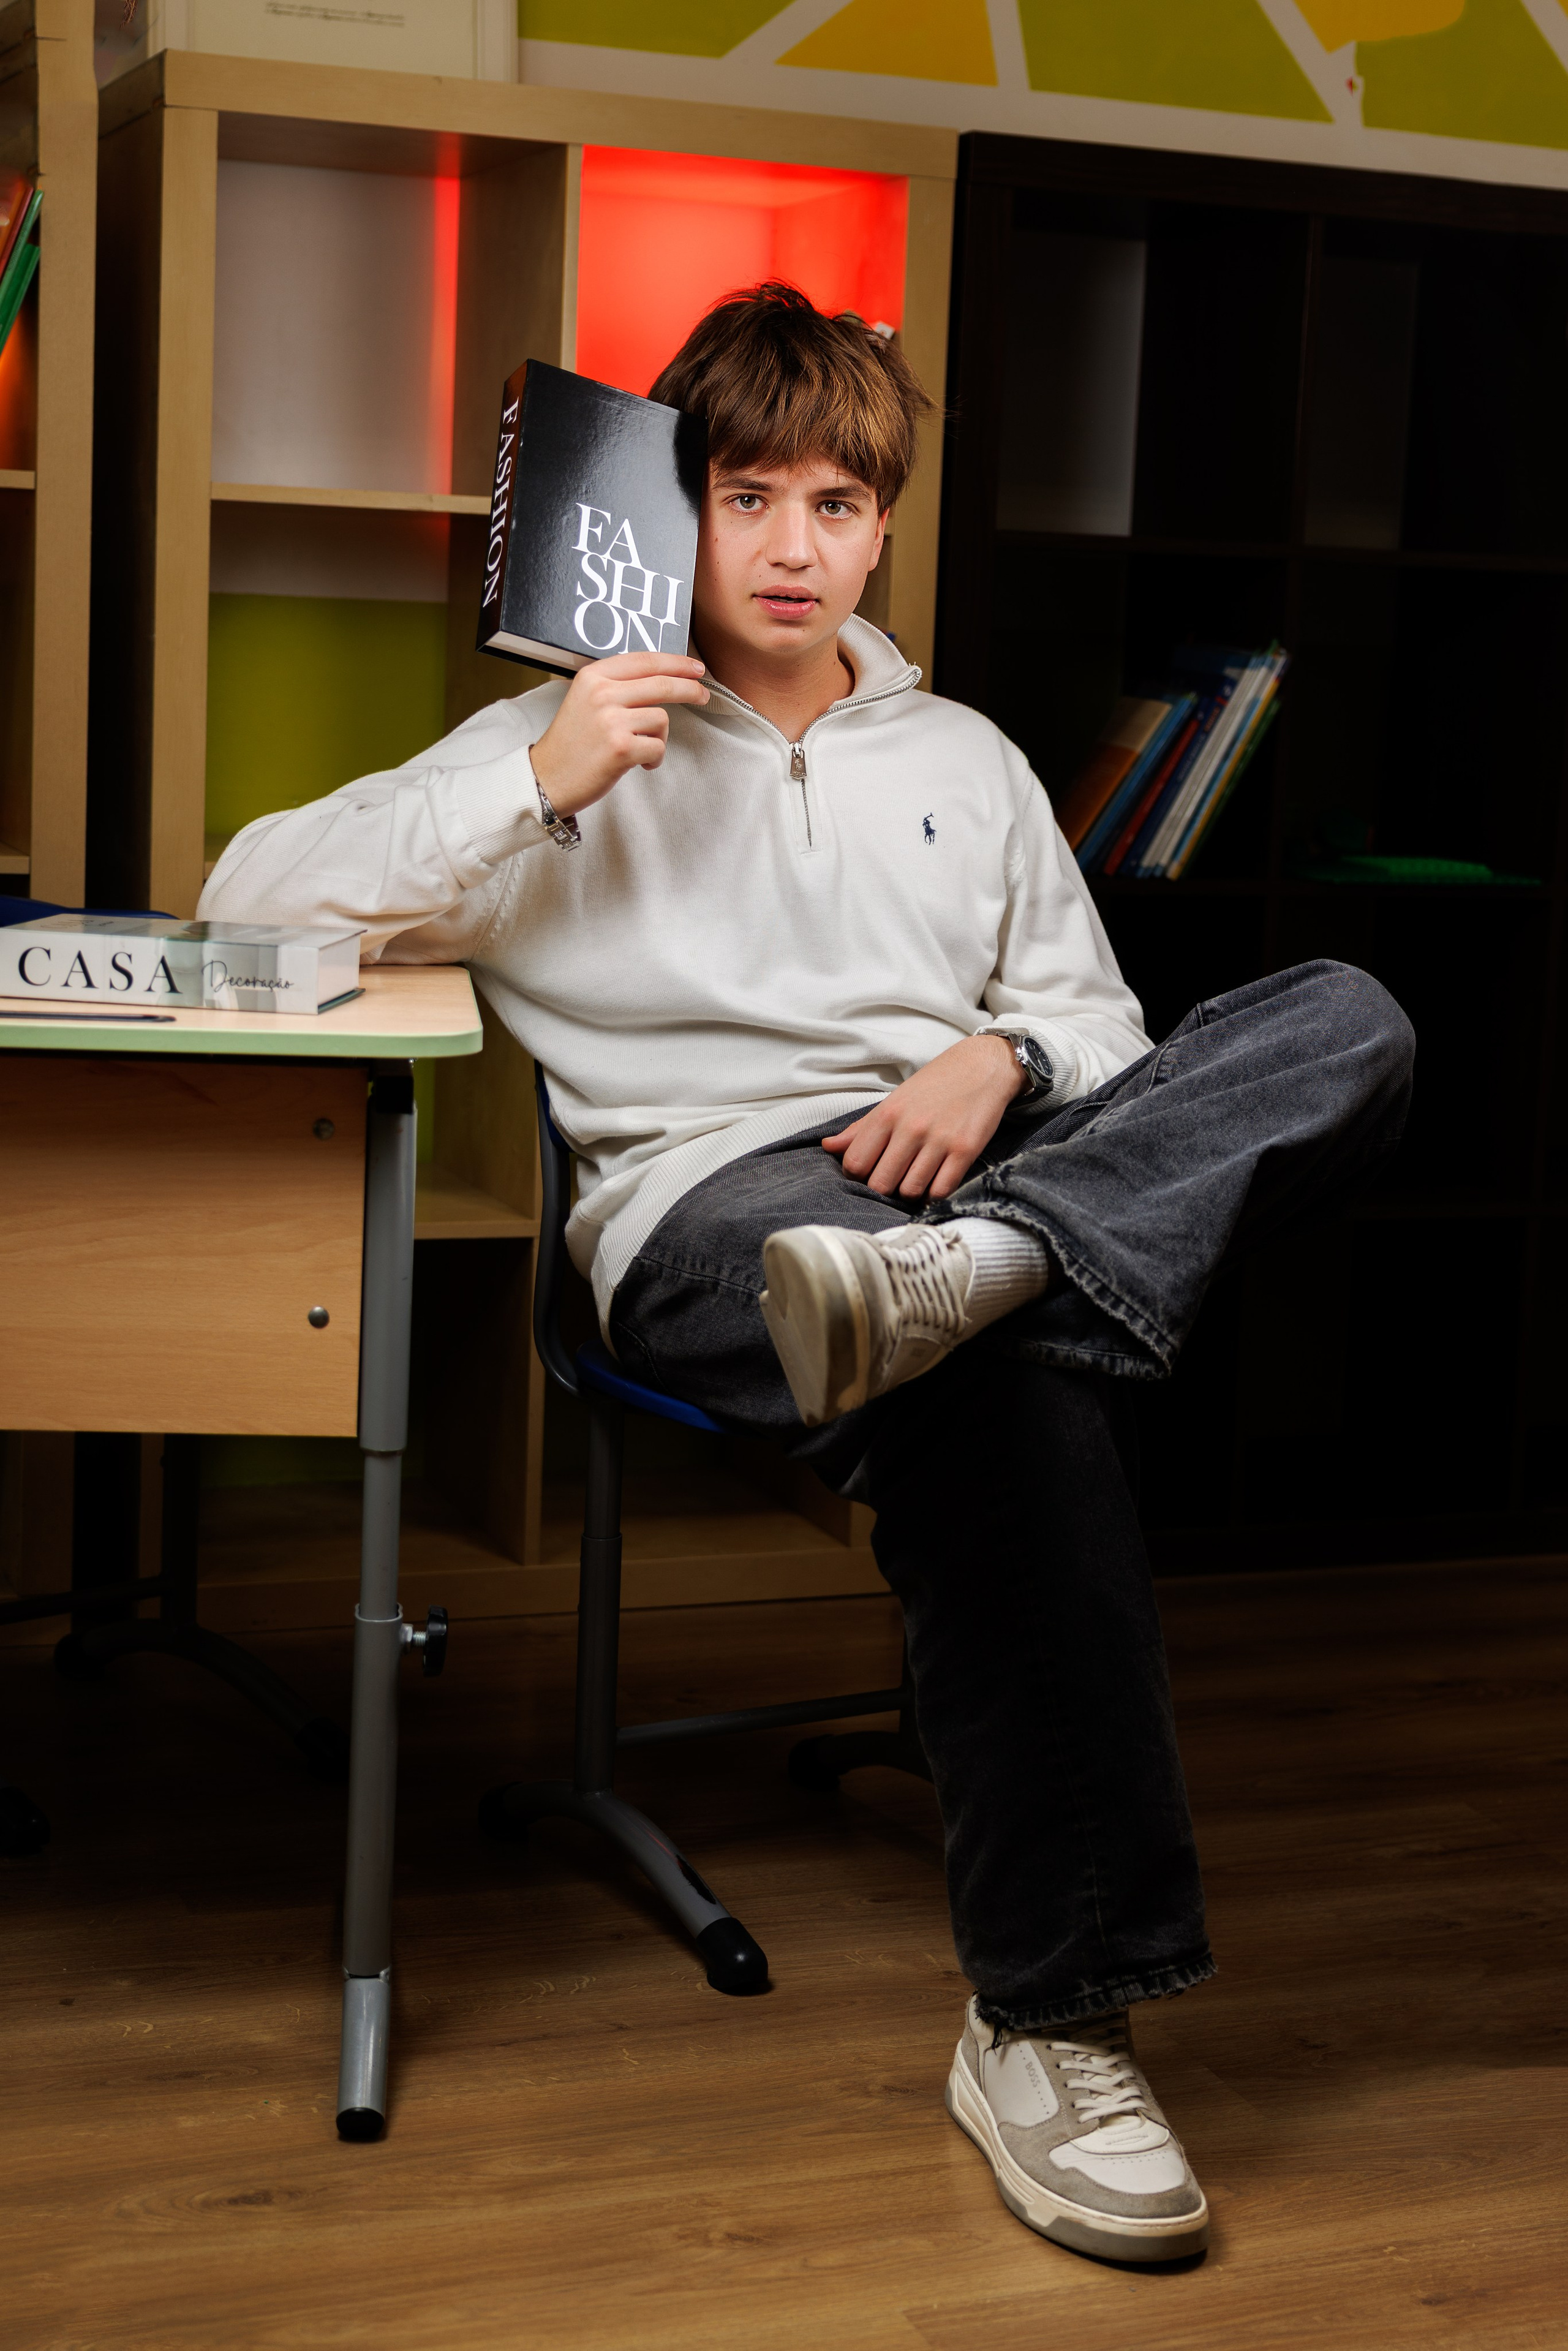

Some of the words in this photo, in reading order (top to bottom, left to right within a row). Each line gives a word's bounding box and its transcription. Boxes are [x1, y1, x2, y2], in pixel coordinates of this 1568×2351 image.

[483, 396, 519, 608] FASHION
[571, 502, 643, 568] FA
[576, 552, 685, 627] SHI
[574, 599, 680, 655] ON
[18, 946, 183, 994] CASA
[201, 959, 294, 992] Decoração
[1025, 2061, 1041, 2088] BOSS
